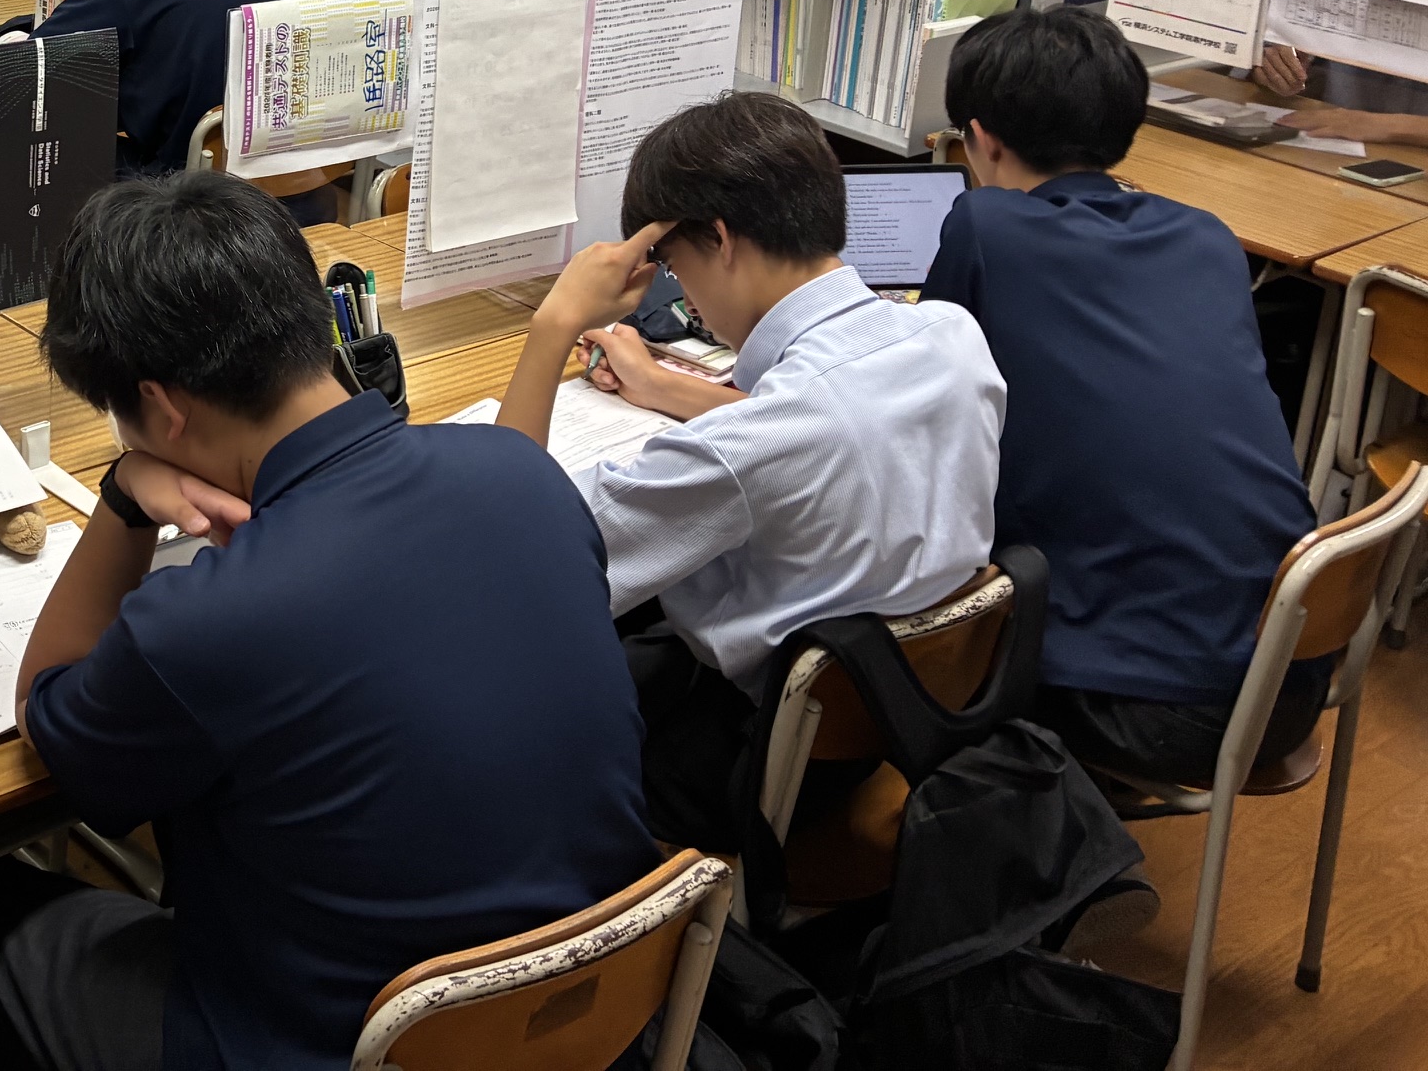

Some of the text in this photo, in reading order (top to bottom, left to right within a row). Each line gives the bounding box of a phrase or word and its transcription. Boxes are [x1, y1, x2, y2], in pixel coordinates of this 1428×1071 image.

[272, 22, 289, 129] 共通テストの
[290, 28, 310, 118] 基礎知識
[362, 9, 387, 111] 進路室
[36, 160, 44, 186] Science
[44, 141, 52, 170] Statistics
